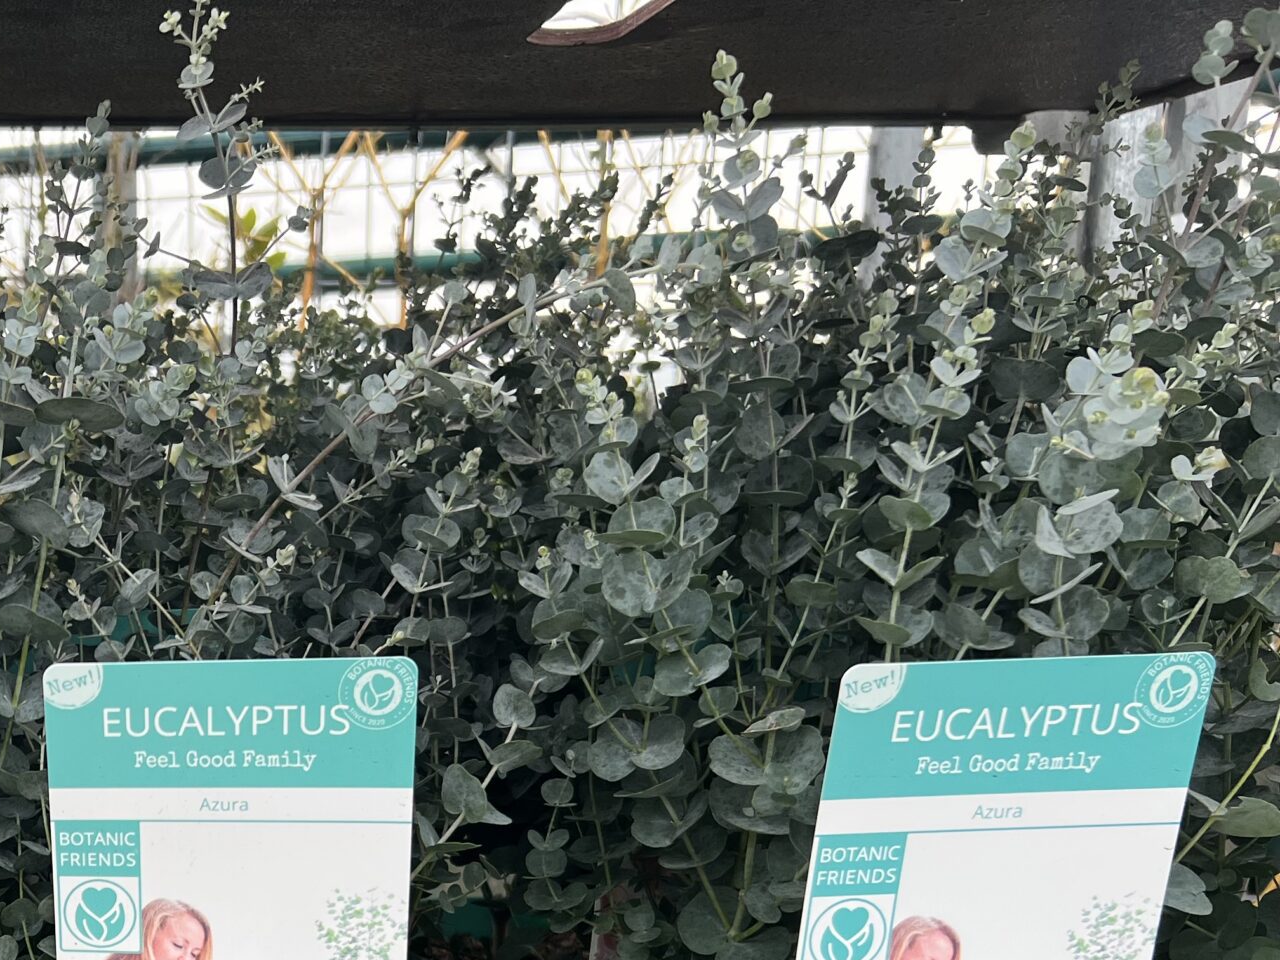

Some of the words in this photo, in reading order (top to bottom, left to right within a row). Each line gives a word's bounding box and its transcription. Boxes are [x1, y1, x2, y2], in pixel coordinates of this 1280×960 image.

[46, 670, 97, 696] New!
[347, 659, 394, 680] BOTANIC
[394, 663, 415, 705] FRIENDS
[844, 670, 897, 698] New!
[1147, 654, 1196, 677] BOTANIC
[1194, 659, 1210, 700] FRIENDS
[102, 704, 350, 738] EUCALYPTUS
[891, 702, 1143, 743] EUCALYPTUS
[134, 751, 180, 769] Feel
[185, 750, 236, 769] Good
[243, 750, 317, 772] Family
[915, 756, 963, 776] Feel
[969, 754, 1019, 774] Good
[1024, 752, 1101, 772] Family
[199, 797, 249, 812] Azura
[972, 804, 1023, 819] Azura
[59, 832, 136, 847] BOTANIC
[60, 852, 136, 867] FRIENDS
[820, 845, 901, 863] BOTANIC
[816, 868, 897, 886] FRIENDS
